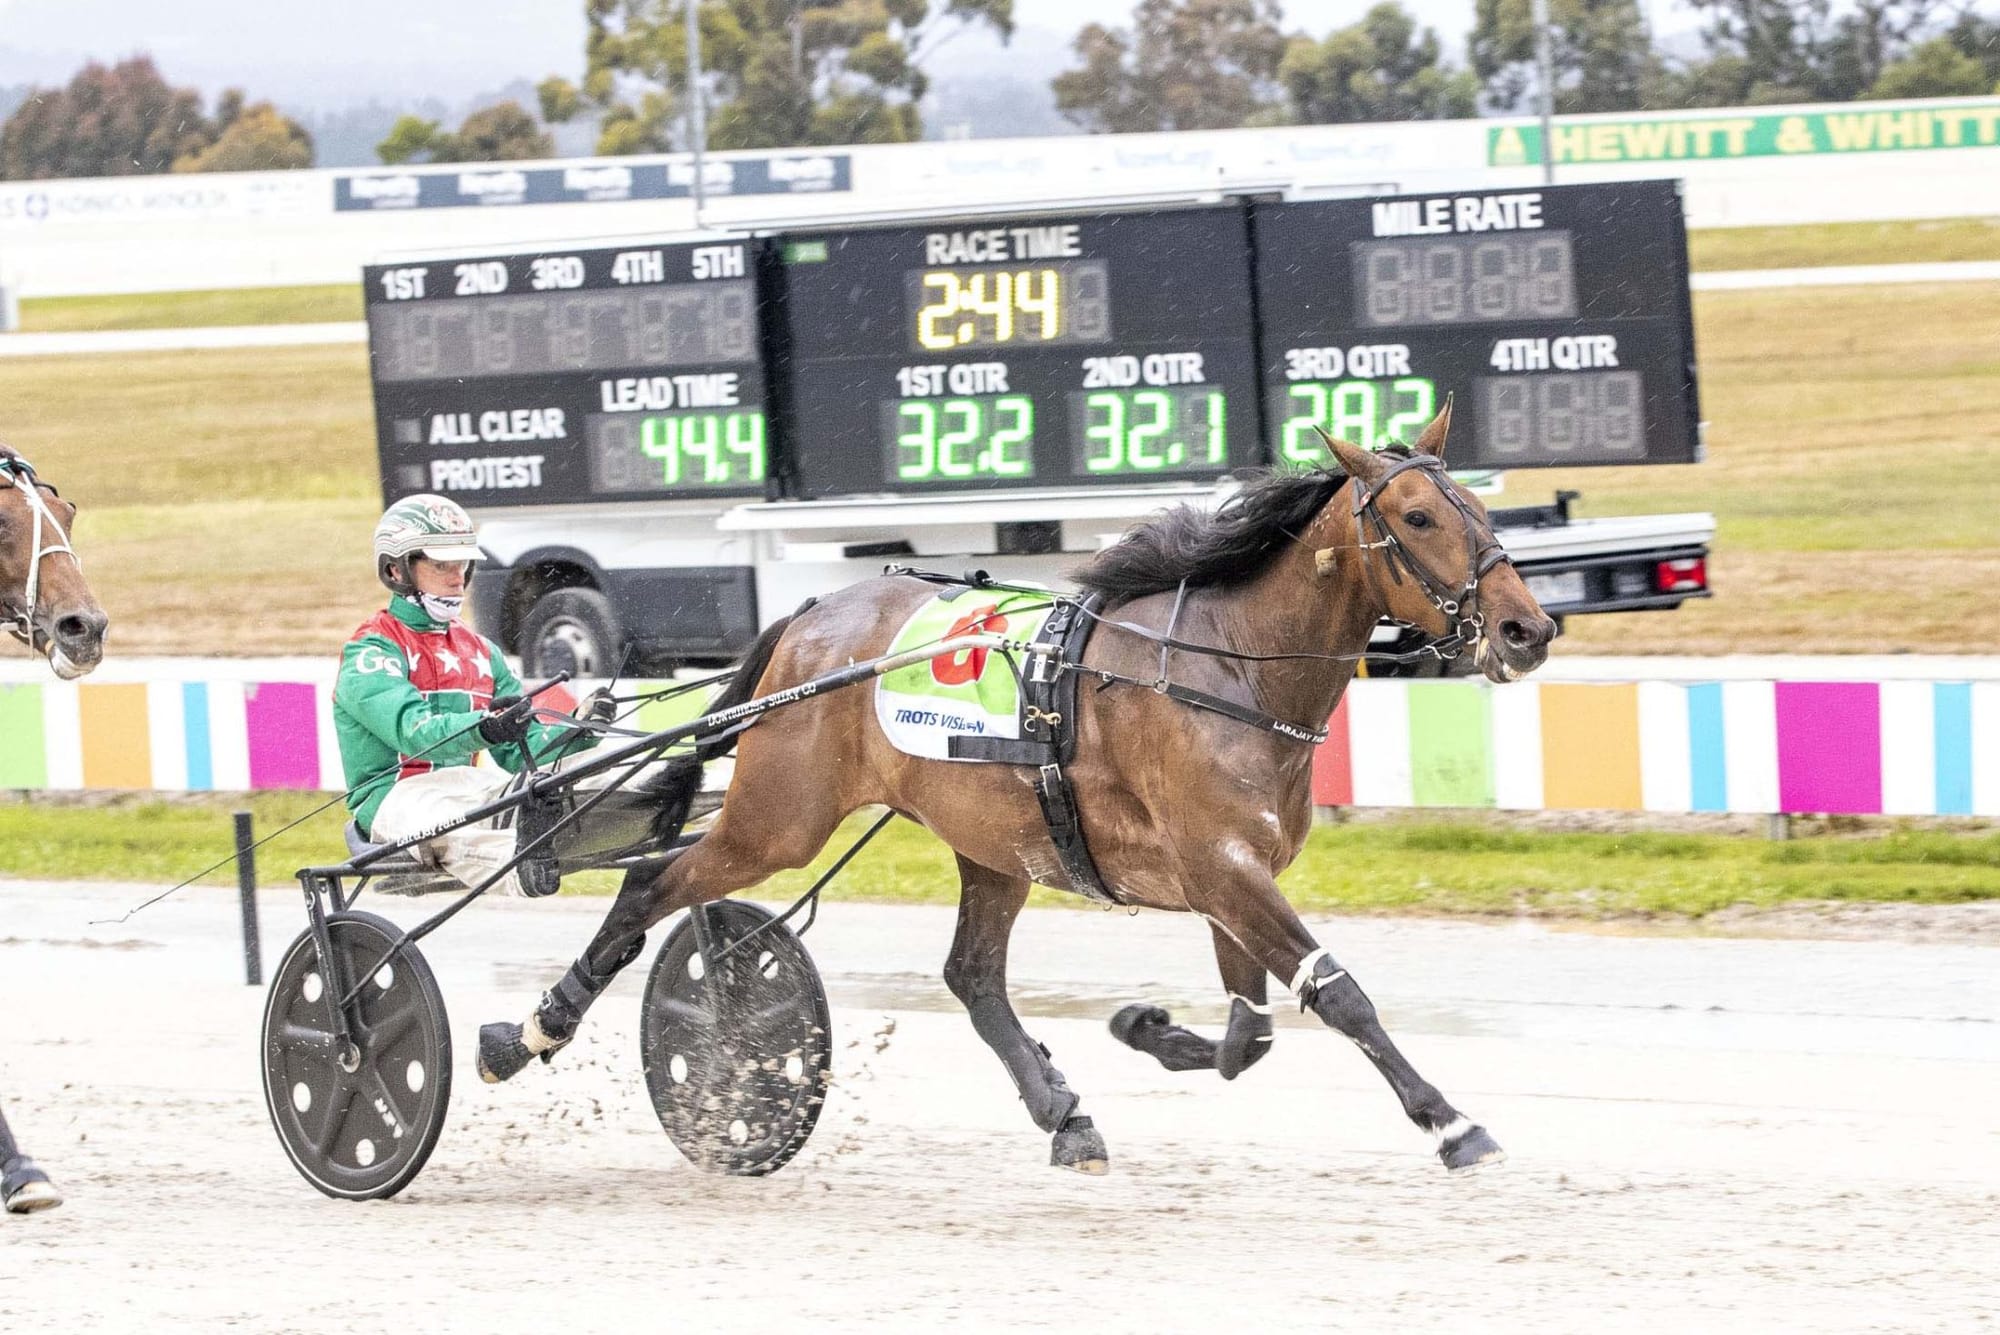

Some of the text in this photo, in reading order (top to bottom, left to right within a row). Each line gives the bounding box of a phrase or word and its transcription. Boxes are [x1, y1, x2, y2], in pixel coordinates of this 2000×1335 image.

[1552, 118, 1755, 162] HEWITT
[1775, 115, 1817, 154] &
[1372, 193, 1544, 238] MILE RATE
[925, 225, 1083, 265] RACE TIME
[381, 245, 745, 301] 1ST 2ND 3RD 4TH 5TH
[1081, 352, 1206, 389] 2ND QTR
[1284, 344, 1412, 382] 3RD QTR
[1490, 335, 1620, 372] 4TH QTR
[601, 372, 740, 413] LEAD TIME
[896, 361, 1010, 397] 1ST QTR
[429, 407, 567, 445] ALL CLEAR
[897, 394, 1035, 480] 32.2
[1085, 390, 1228, 474] 32.1
[641, 411, 767, 485] 44.4
[430, 455, 545, 491] PROTEST
[895, 708, 939, 726] TROTS
[1273, 720, 1313, 742] LARAJAY
